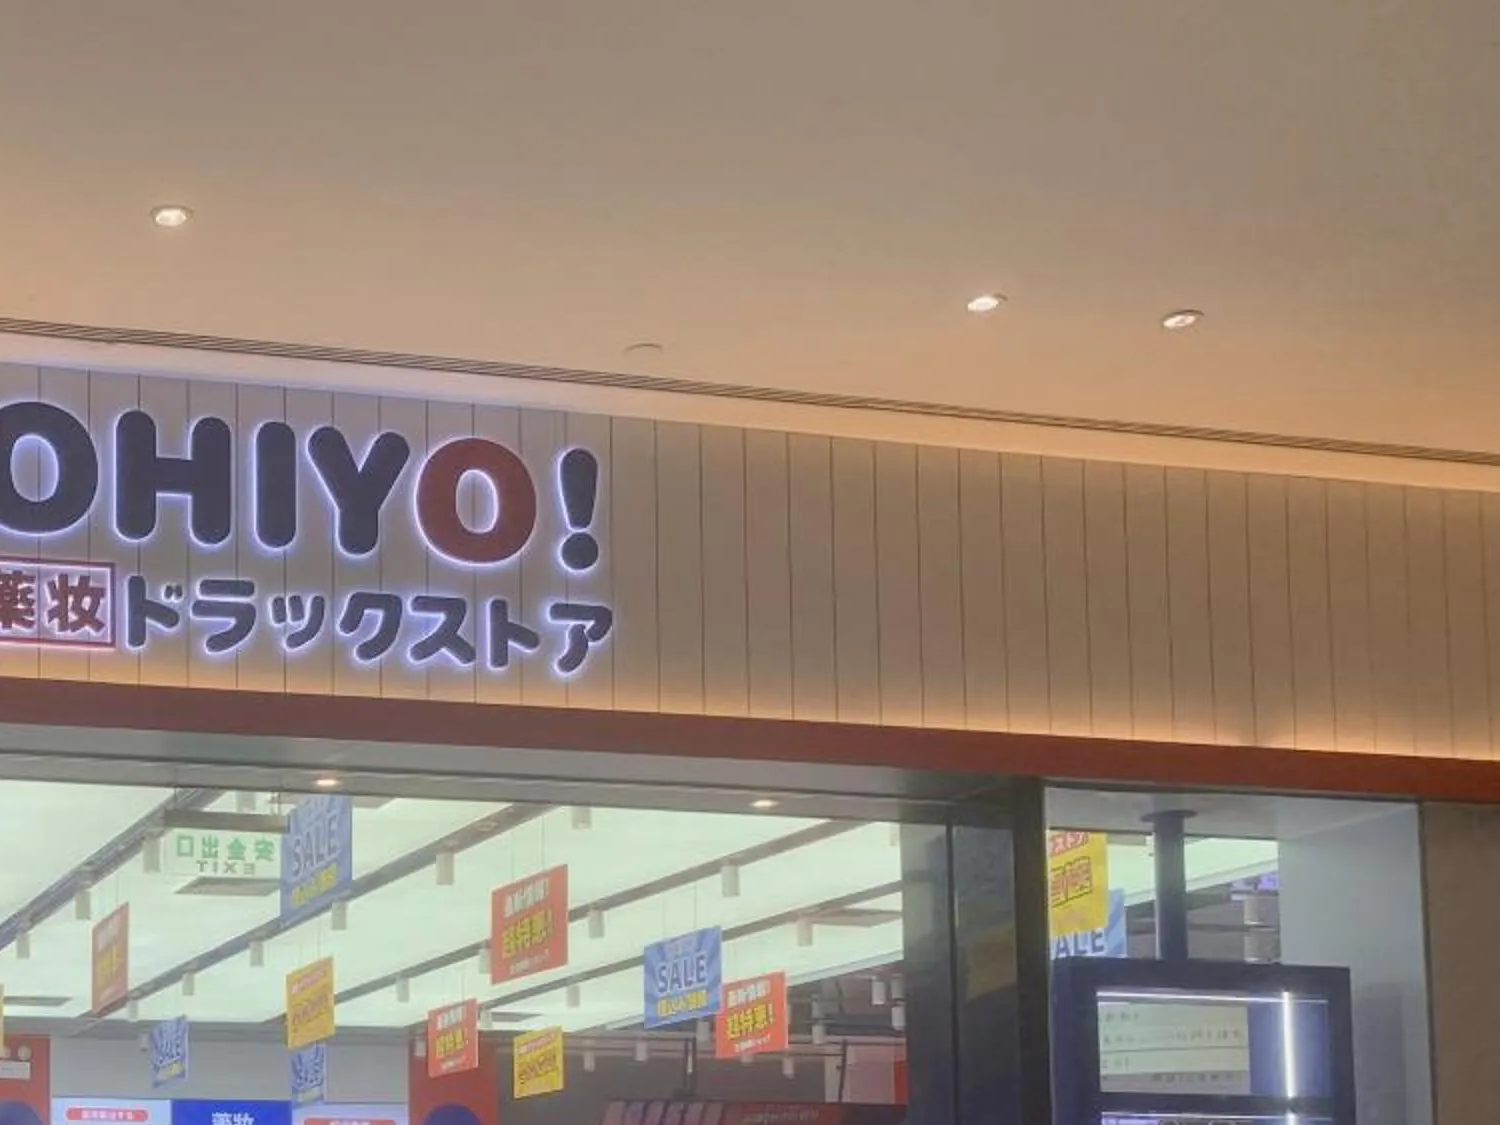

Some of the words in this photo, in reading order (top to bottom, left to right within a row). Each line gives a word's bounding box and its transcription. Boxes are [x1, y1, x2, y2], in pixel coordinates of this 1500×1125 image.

[125, 575, 613, 675] ドラックストア
[1055, 928, 1106, 955] ALE
[657, 954, 708, 993] SALE
